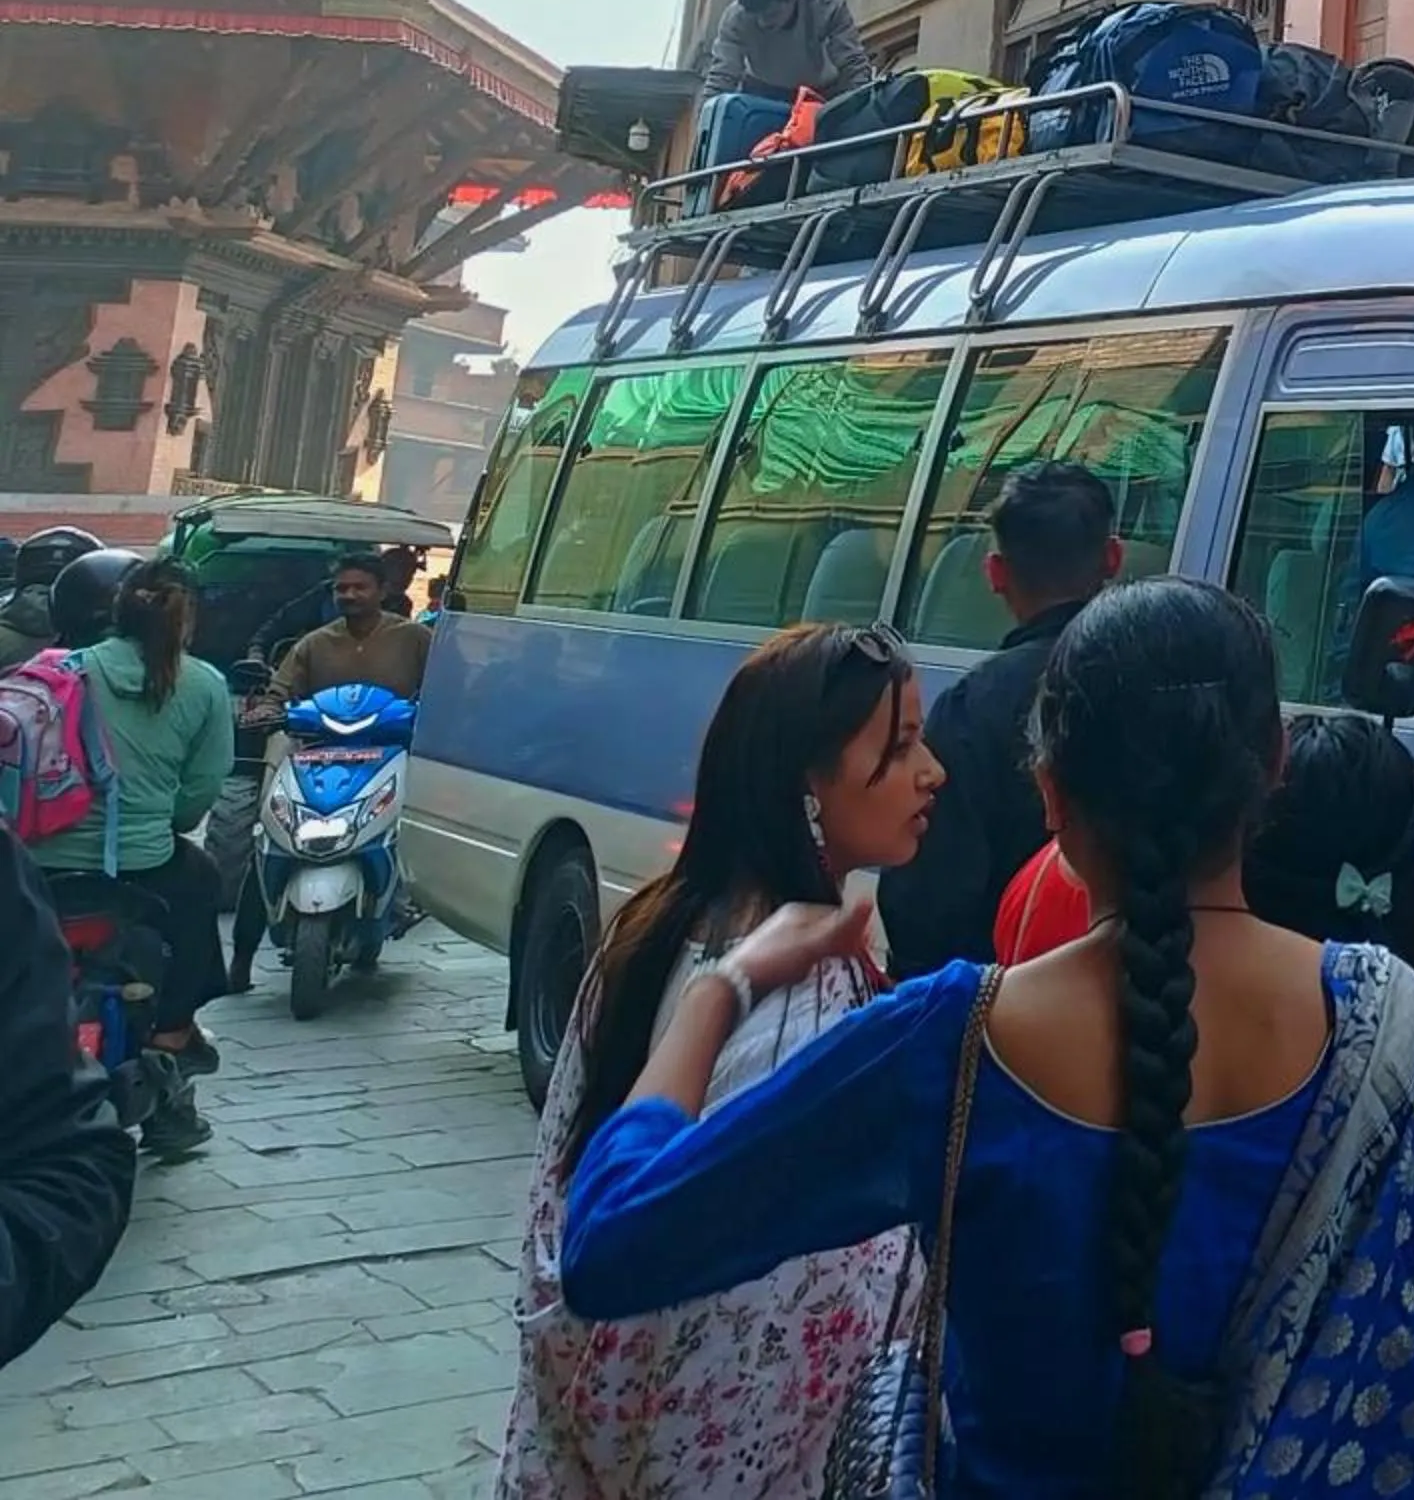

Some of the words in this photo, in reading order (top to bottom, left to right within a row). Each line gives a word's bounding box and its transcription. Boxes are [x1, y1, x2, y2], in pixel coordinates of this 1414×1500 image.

[1181, 54, 1203, 69] THE
[1168, 66, 1205, 80] NORTH
[1178, 74, 1206, 88] FACE
